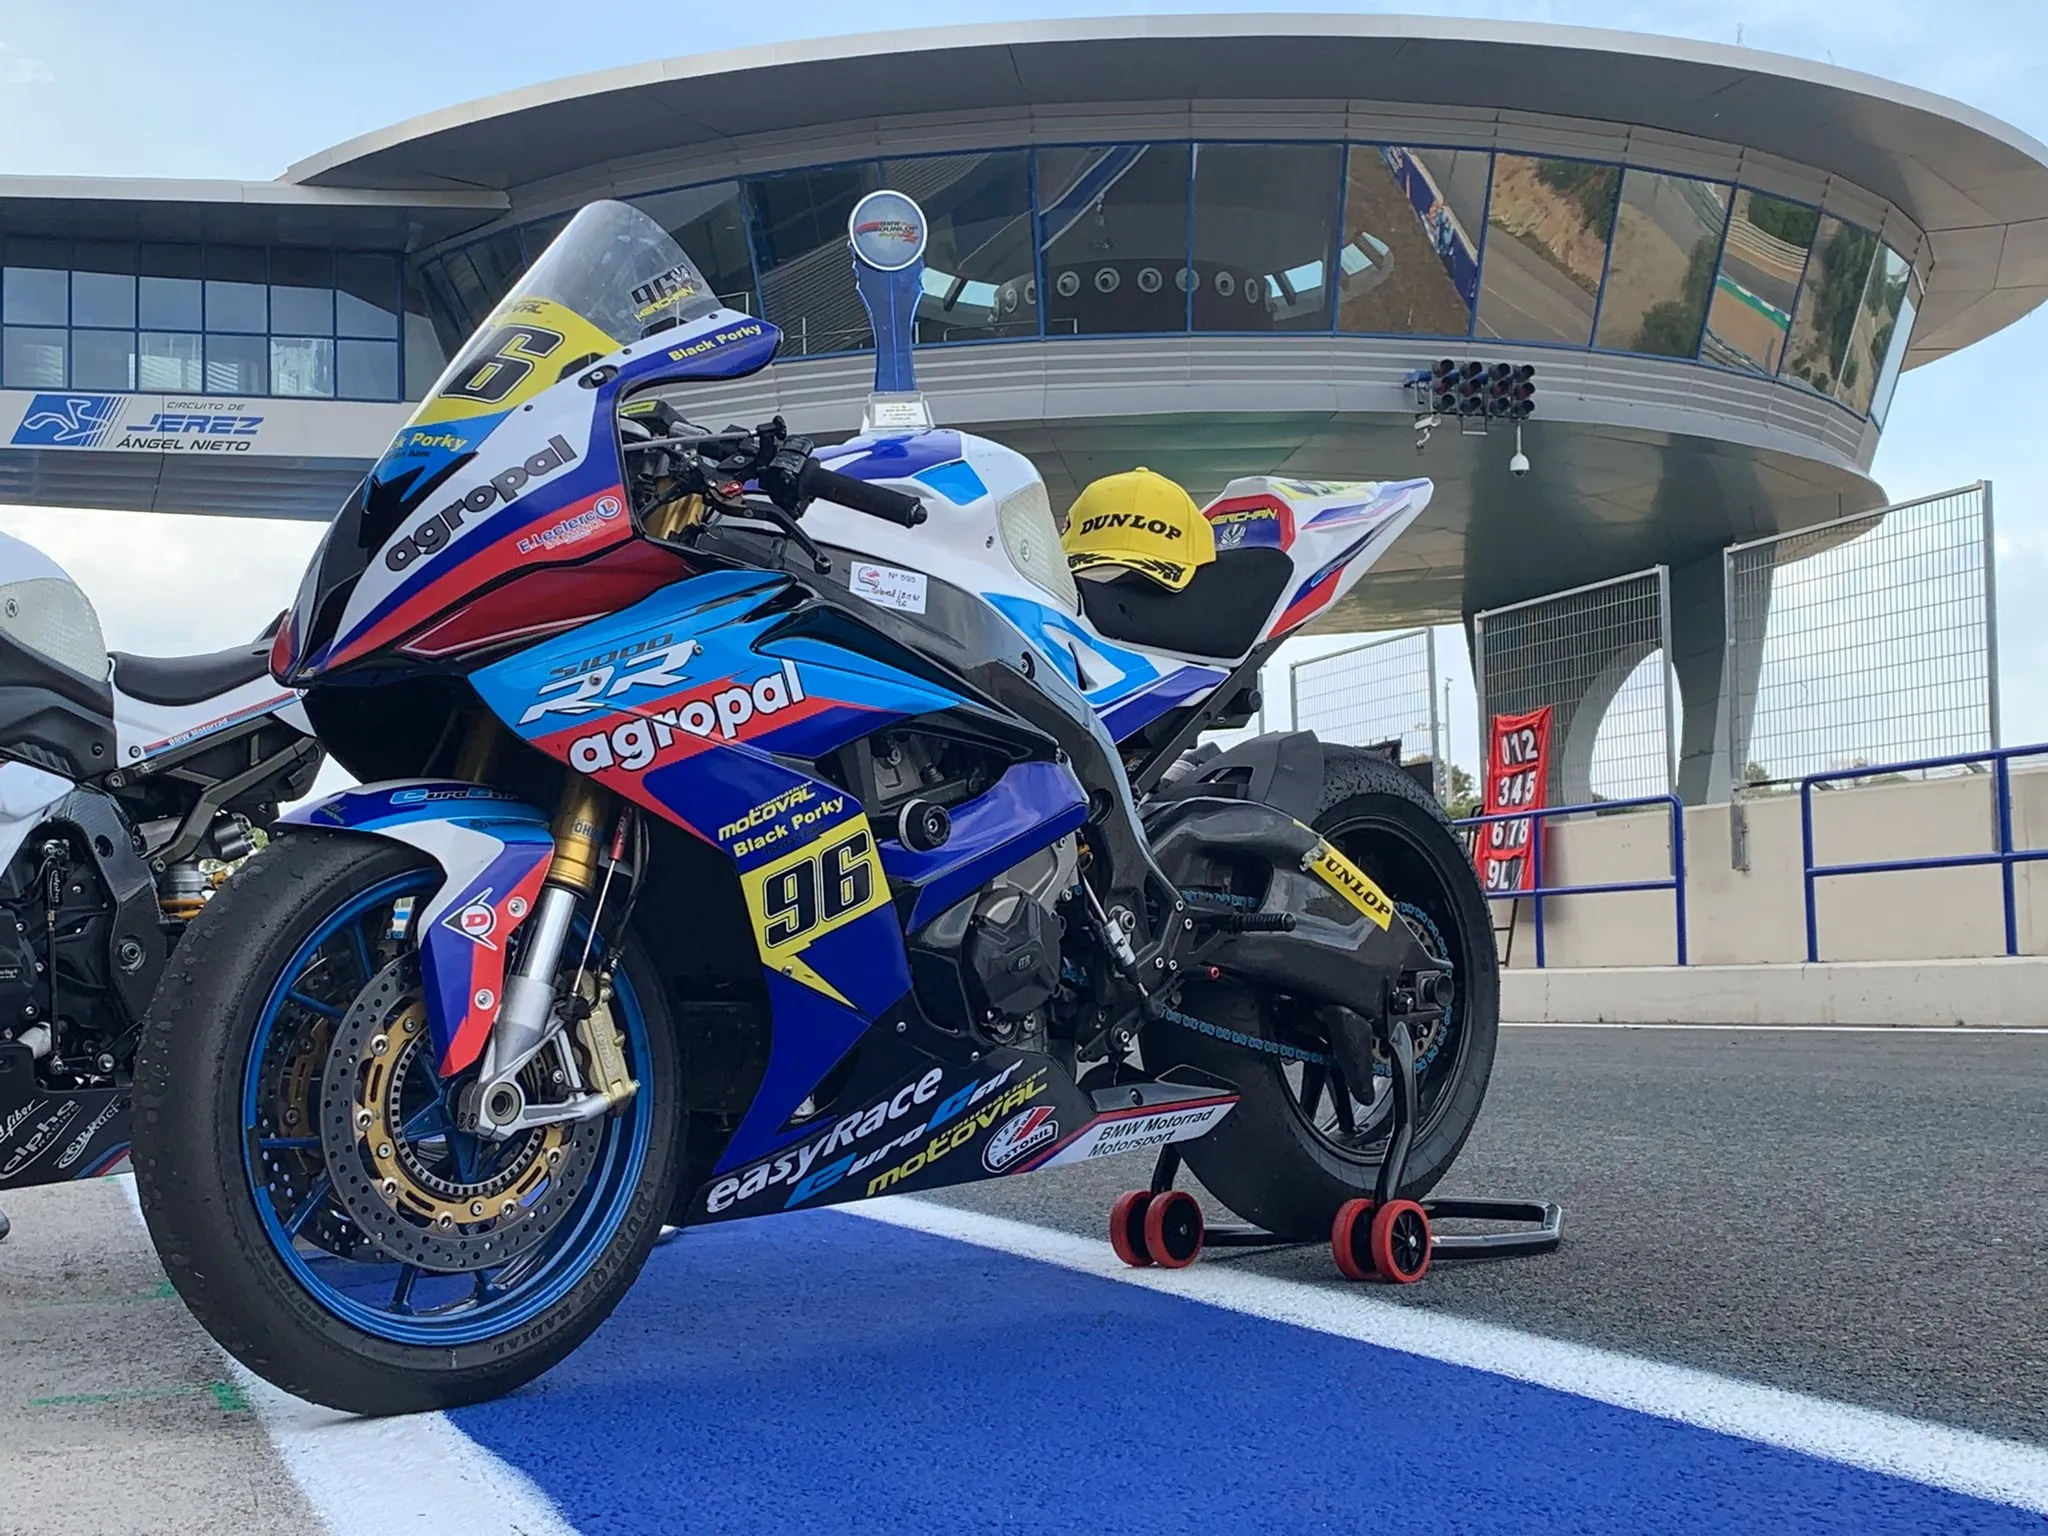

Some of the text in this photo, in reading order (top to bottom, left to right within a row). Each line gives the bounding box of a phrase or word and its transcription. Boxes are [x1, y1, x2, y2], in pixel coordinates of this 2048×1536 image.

[667, 338, 716, 362] Black
[715, 323, 762, 345] Porky
[126, 413, 265, 436] JEREZ
[166, 401, 246, 412] CIRCUITO DE
[116, 434, 252, 452] ÁNGEL NIETO
[408, 432, 468, 453] Porky
[385, 434, 579, 572] agropal
[1210, 507, 1278, 525] ERCHAN
[517, 510, 597, 552] E.Leclerc
[1079, 513, 1183, 541] DUNLOP
[551, 632, 673, 677] S1000
[516, 639, 697, 726] RR
[168, 717, 229, 746] BMW Motorrad
[568, 658, 805, 774] agropal
[1498, 771, 1536, 807] 345
[732, 796, 845, 858] Black Porky
[763, 829, 874, 949] 96
[3, 1100, 77, 1172] alpha
[706, 1067, 943, 1214] easyRace
[1087, 1129, 1176, 1158] Motorsport
[1097, 1107, 1216, 1142] BMW Motorrad
[996, 1127, 1052, 1166] ESTORIL
